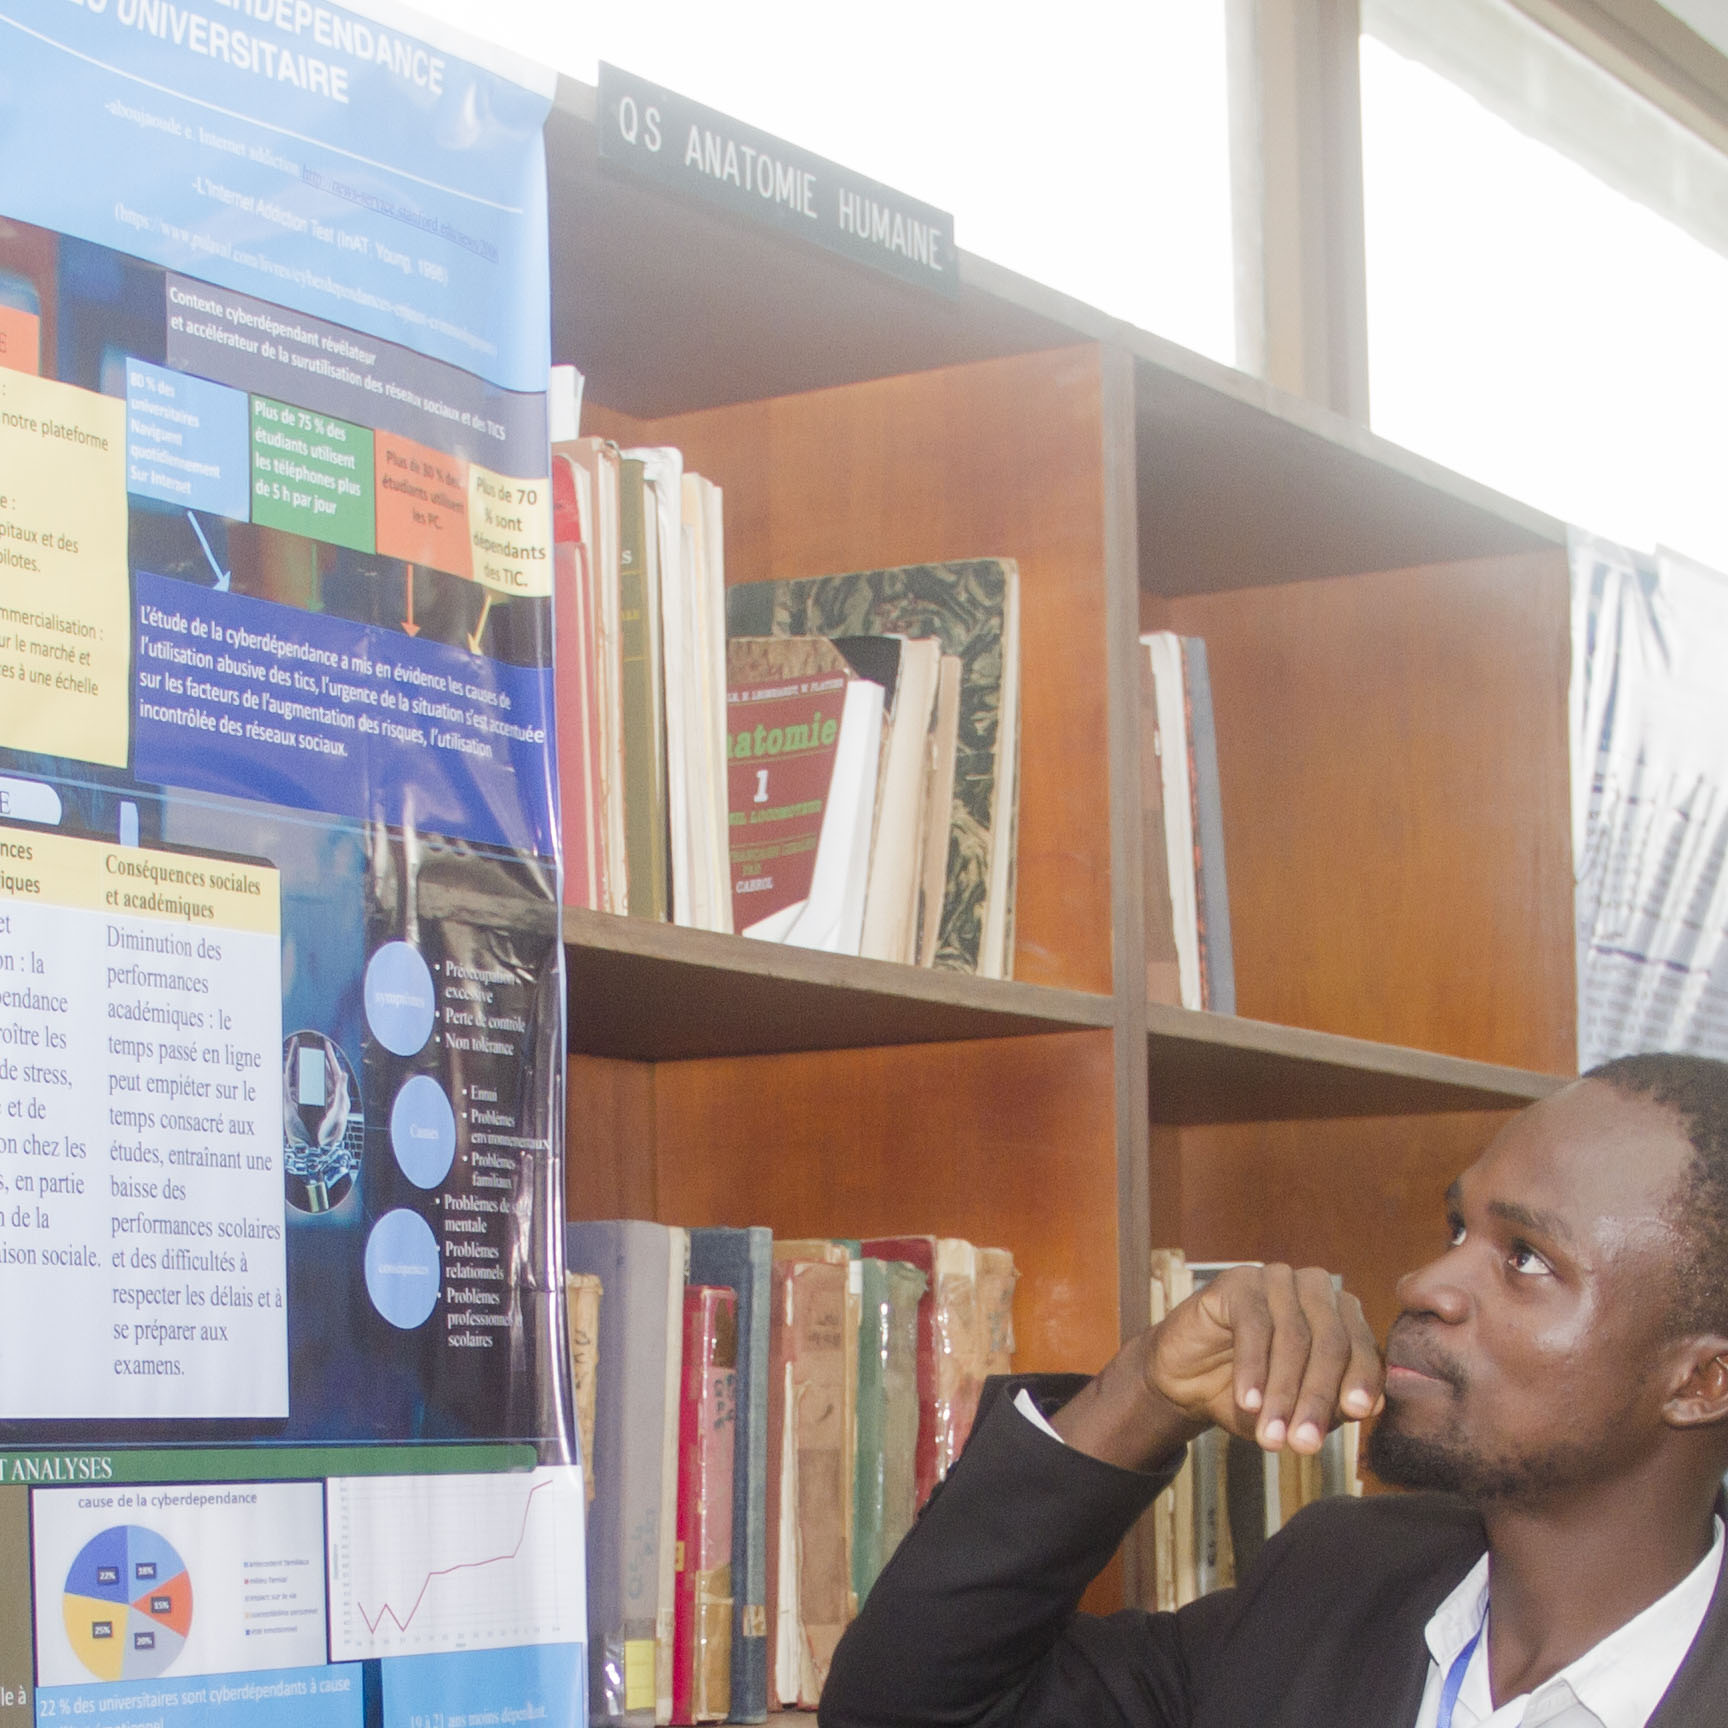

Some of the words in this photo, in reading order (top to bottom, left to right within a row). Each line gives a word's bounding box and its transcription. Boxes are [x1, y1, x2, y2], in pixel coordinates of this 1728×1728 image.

[117, 0, 349, 104] UNIVERSITAIRE
[213, 0, 445, 95] DEPENDANCE
[684, 125, 819, 220] ANATOMIE
[838, 188, 944, 272] HUMAINE
[168, 286, 224, 318] Contexte
[225, 306, 320, 348] cyberdépendant
[320, 336, 377, 366] révélateur
[1, 411, 38, 433] notre
[40, 419, 109, 452] plateforme
[253, 399, 279, 422] Plus
[280, 408, 296, 427] de
[297, 411, 313, 432] 75
[313, 417, 325, 435] %
[325, 421, 347, 442] des
[476, 476, 497, 499] Plus
[497, 483, 513, 504] de
[516, 488, 538, 506] 70
[139, 697, 217, 732] incontrôlée
[218, 714, 244, 737] des
[245, 720, 297, 747] réseaux
[298, 733, 349, 758] sociaux.
[753, 769, 769, 803] 1
[104, 853, 206, 888] Conséquences
[209, 872, 261, 896] sociales
[445, 1033, 469, 1051] Non
[445, 1219, 487, 1235] mentale
[446, 1263, 504, 1281] relationnels
[448, 1332, 493, 1349] scolaires
[113, 1359, 185, 1376] examens.
[11, 1456, 113, 1481] ANALYSES
[77, 1497, 114, 1509] cause
[116, 1494, 134, 1508] de
[136, 1492, 148, 1507] la
[150, 1490, 258, 1510] cyberdependance
[40, 1699, 56, 1717] 22
[59, 1698, 71, 1715] %
[73, 1697, 95, 1715] des
[98, 1692, 179, 1712] universitaires
[181, 1689, 207, 1705] sont
[209, 1680, 308, 1705] cyberdépendants
[309, 1678, 317, 1695] à
[319, 1678, 351, 1693] cause
